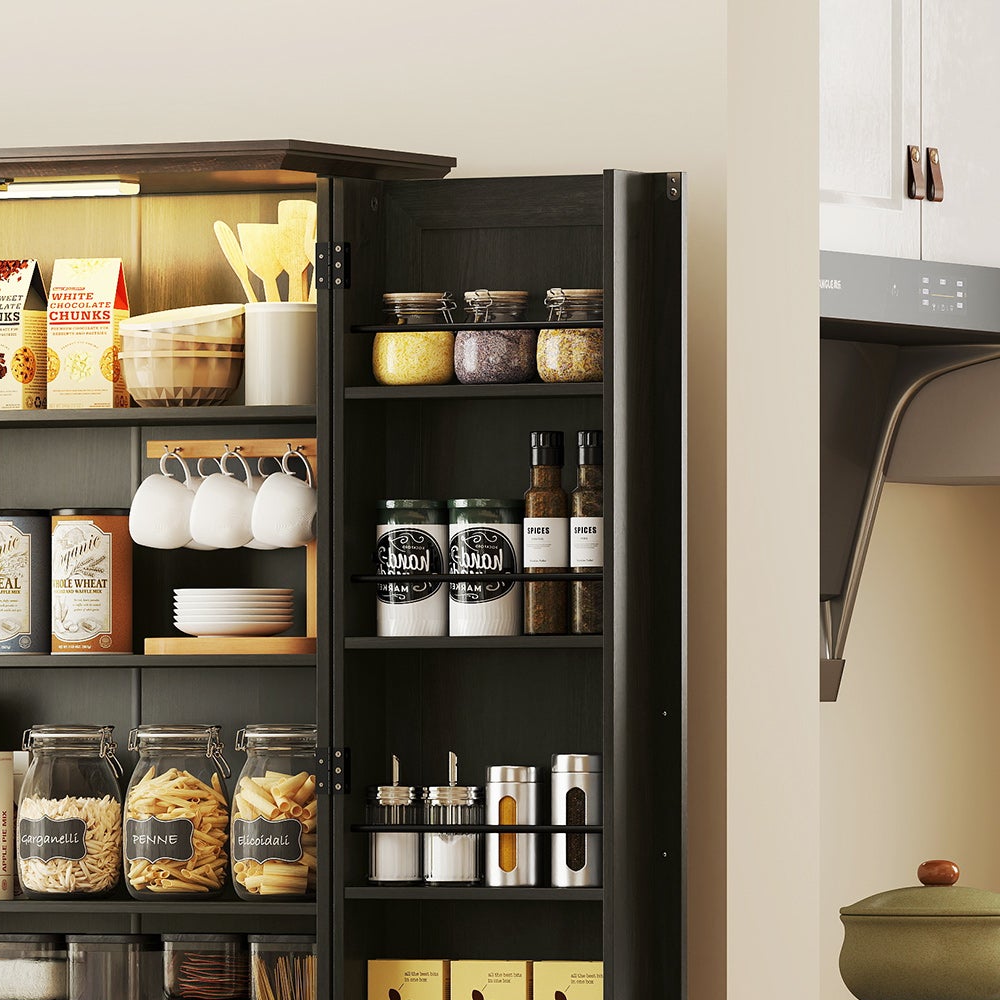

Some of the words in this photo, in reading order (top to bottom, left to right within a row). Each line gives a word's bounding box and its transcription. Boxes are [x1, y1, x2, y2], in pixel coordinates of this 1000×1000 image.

[49, 311, 110, 320] CHUNKS
[74, 579, 108, 588] WHEAT
[22, 833, 79, 847] Garganelli
[132, 835, 178, 844] PENNE
[238, 835, 290, 846] Elicoidali
